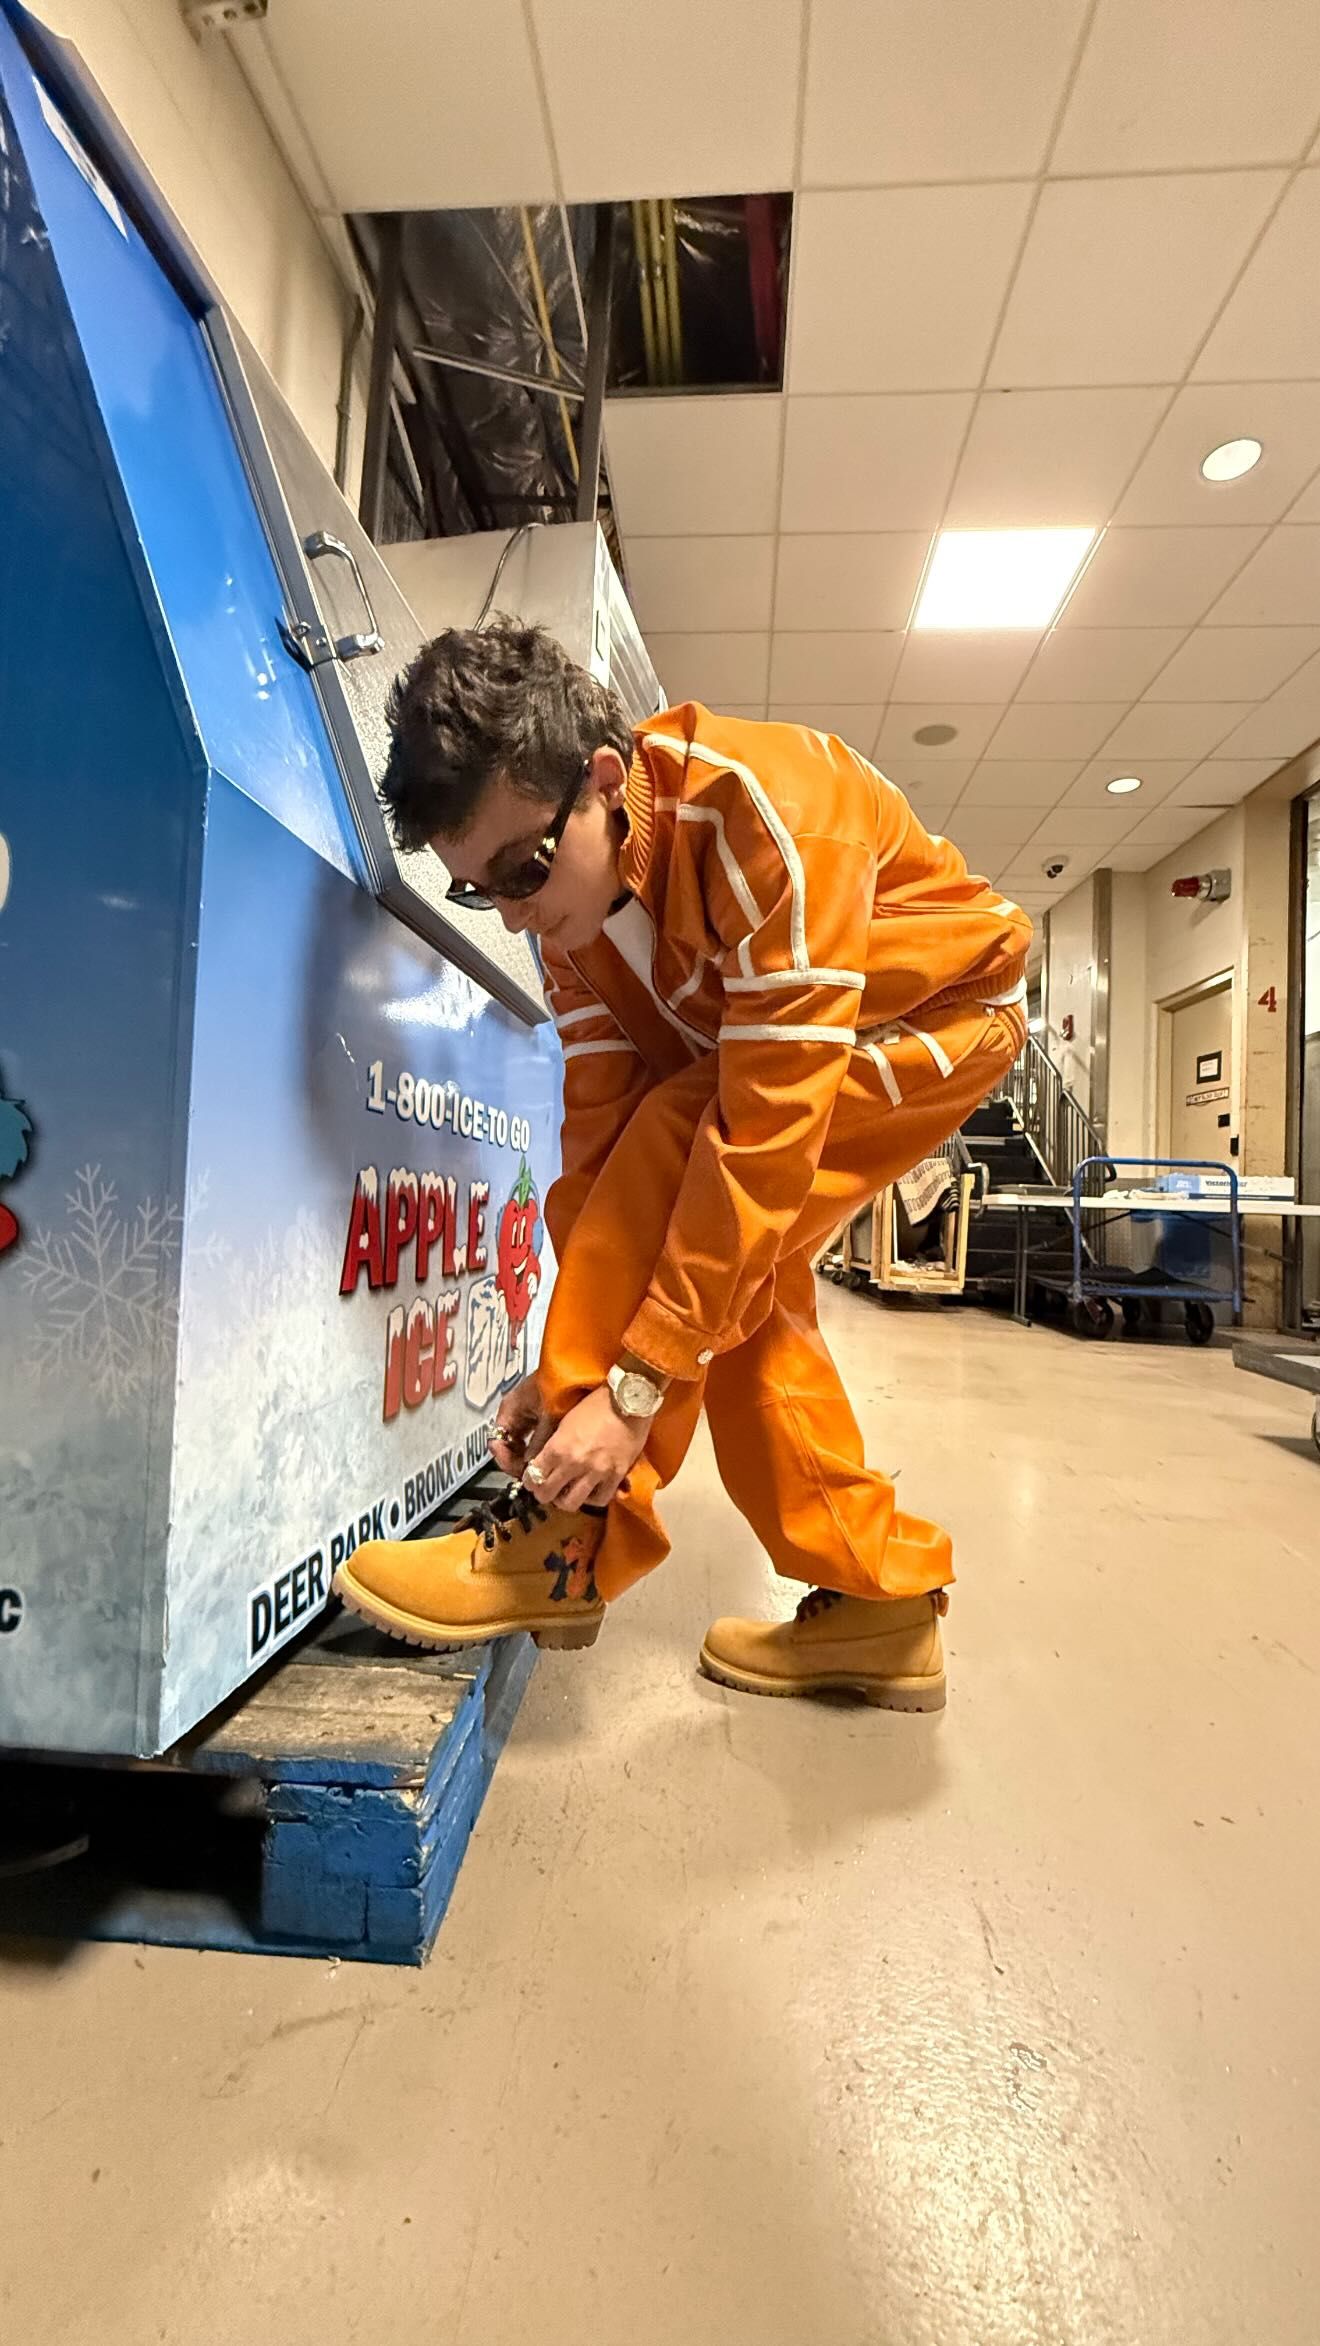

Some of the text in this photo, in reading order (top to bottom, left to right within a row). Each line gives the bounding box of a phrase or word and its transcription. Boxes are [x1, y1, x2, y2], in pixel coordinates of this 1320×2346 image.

[1258, 986, 1277, 1013] 4
[510, 1115, 530, 1153] GO
[340, 1165, 489, 1295] APPLE
[383, 1289, 460, 1423] ICE
[250, 1549, 326, 1660] DEER
[404, 1449, 456, 1525] BRONX
[466, 1417, 495, 1471] HUD
